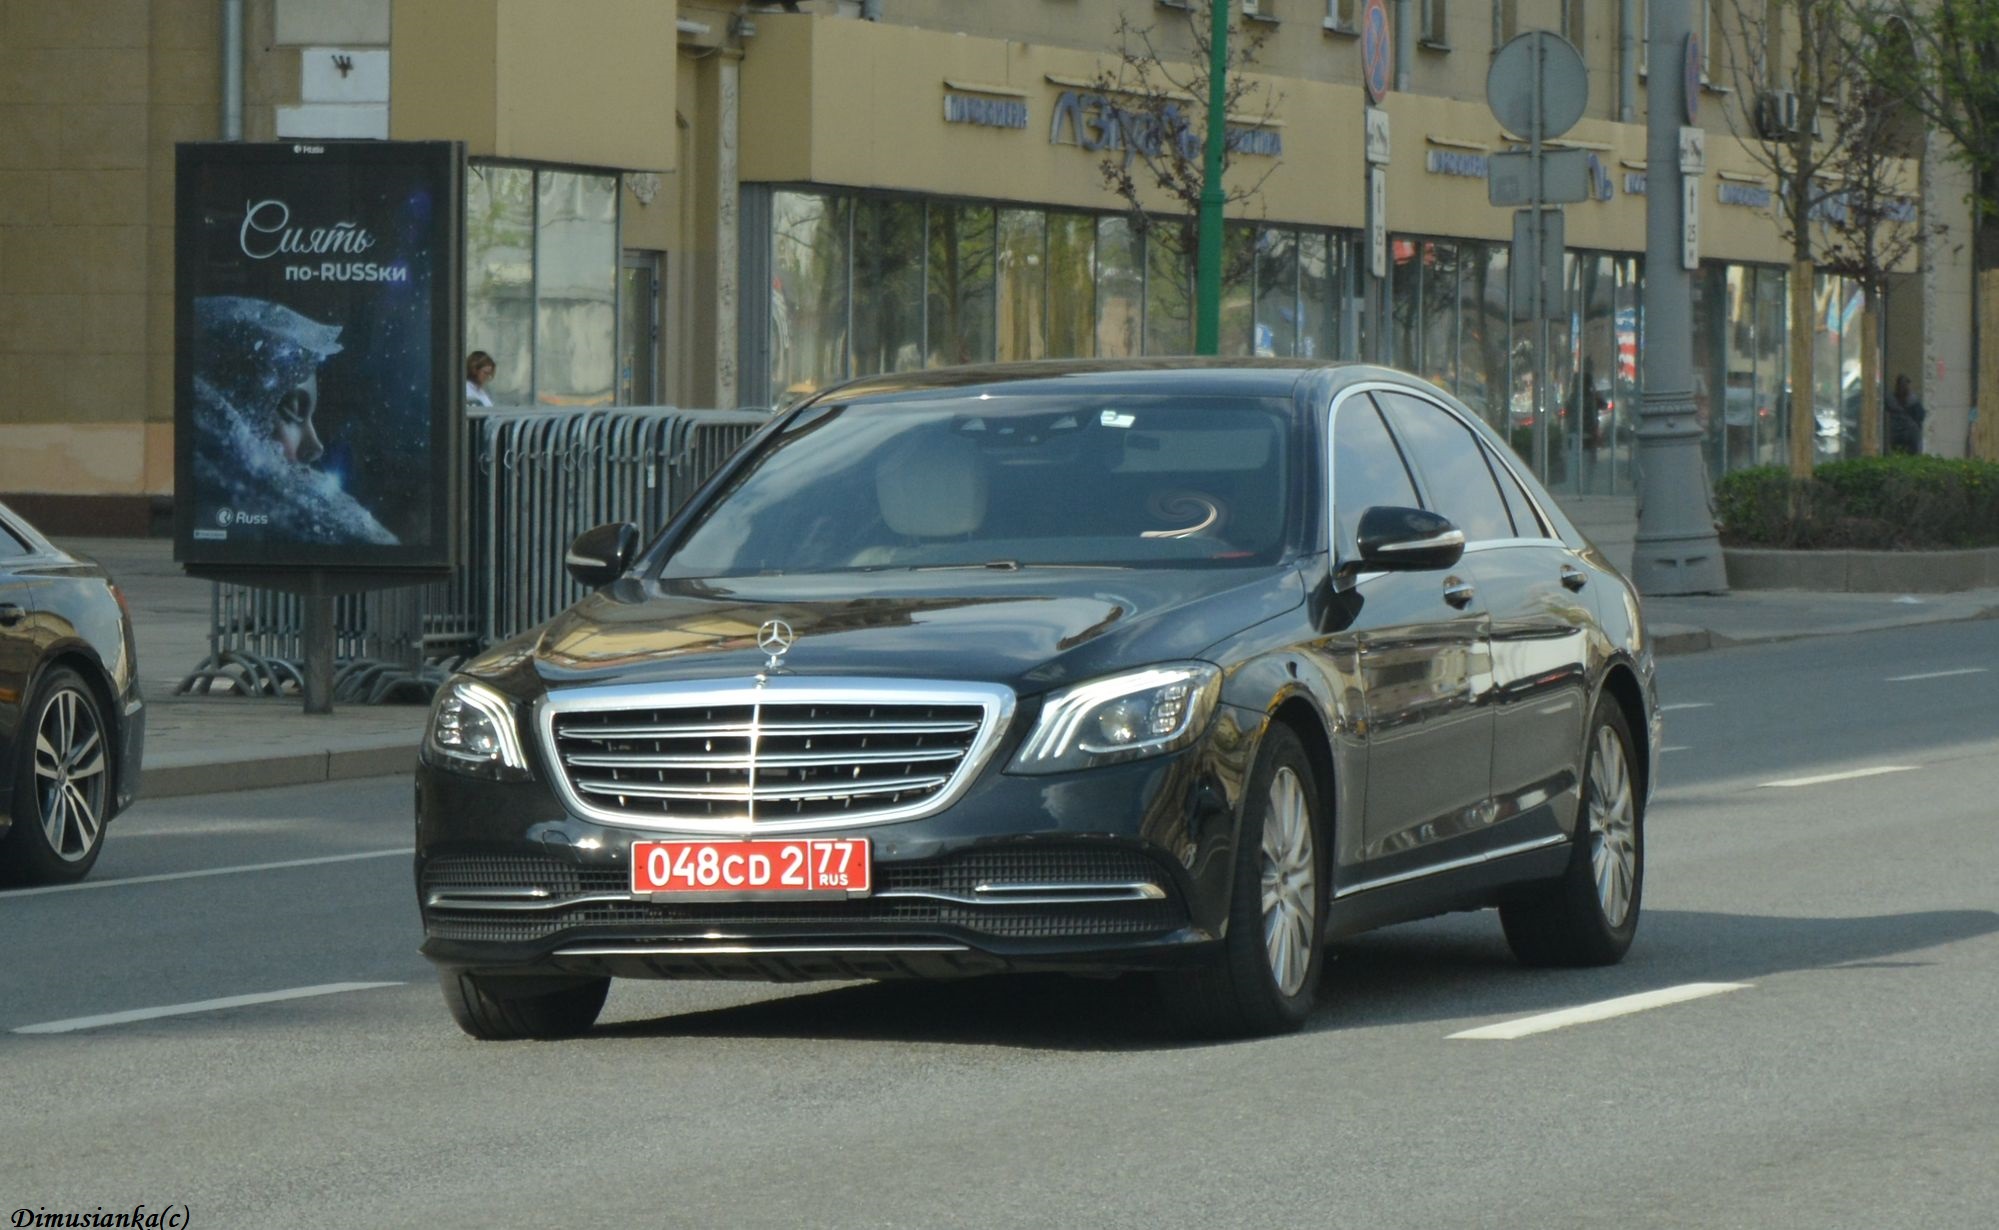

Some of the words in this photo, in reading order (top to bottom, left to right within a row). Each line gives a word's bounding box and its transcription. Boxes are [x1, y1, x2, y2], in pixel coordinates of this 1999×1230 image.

[240, 199, 376, 260] Сиять
[285, 263, 407, 282] по-RUSSки
[235, 511, 268, 525] Russ
[647, 846, 771, 887] 048CD
[780, 846, 804, 886] 2
[813, 843, 853, 873] 77
[819, 874, 849, 886] RUS
